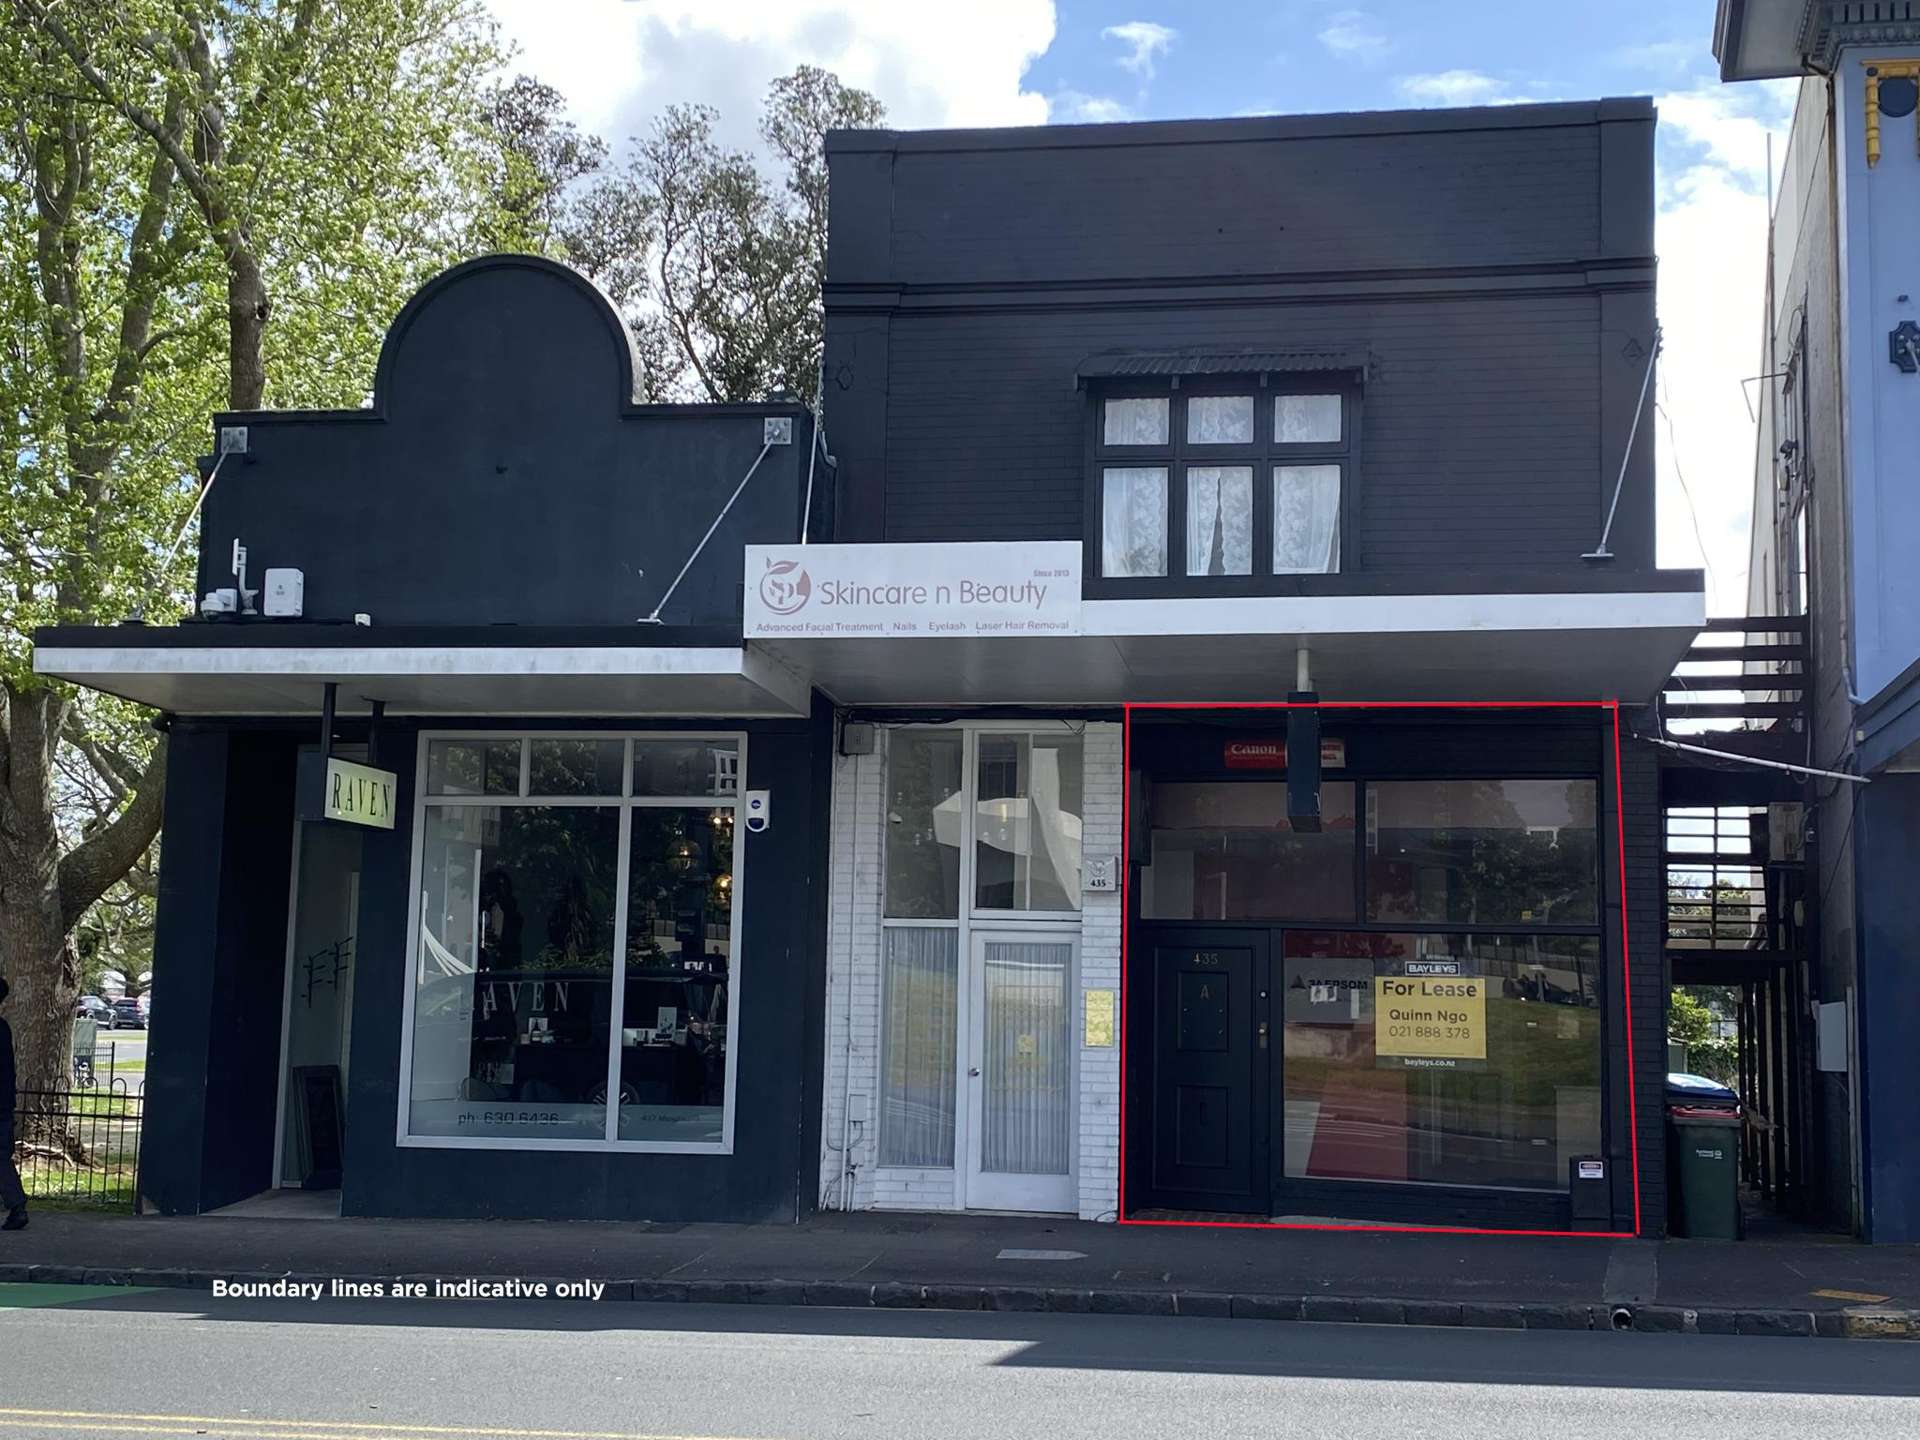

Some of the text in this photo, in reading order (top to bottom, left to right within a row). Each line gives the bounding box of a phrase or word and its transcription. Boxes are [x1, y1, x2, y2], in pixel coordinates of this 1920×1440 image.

[820, 579, 1047, 610] Skincare n Beauty
[756, 620, 1069, 632] Advanced Facial Treatment Nails Eyelash Laser Hair Removal
[1231, 743, 1276, 754] Canon
[332, 773, 391, 817] RAVEN
[1090, 879, 1106, 888] 435
[1193, 952, 1218, 964] 435
[1408, 964, 1457, 973] BAYLEYS
[1383, 980, 1477, 997] For Lease
[1389, 1009, 1468, 1023] Quinn Ngo
[1389, 1026, 1470, 1039] 021 888 378
[1404, 1058, 1456, 1067] bayleys.co.nz
[484, 1111, 514, 1125] 630
